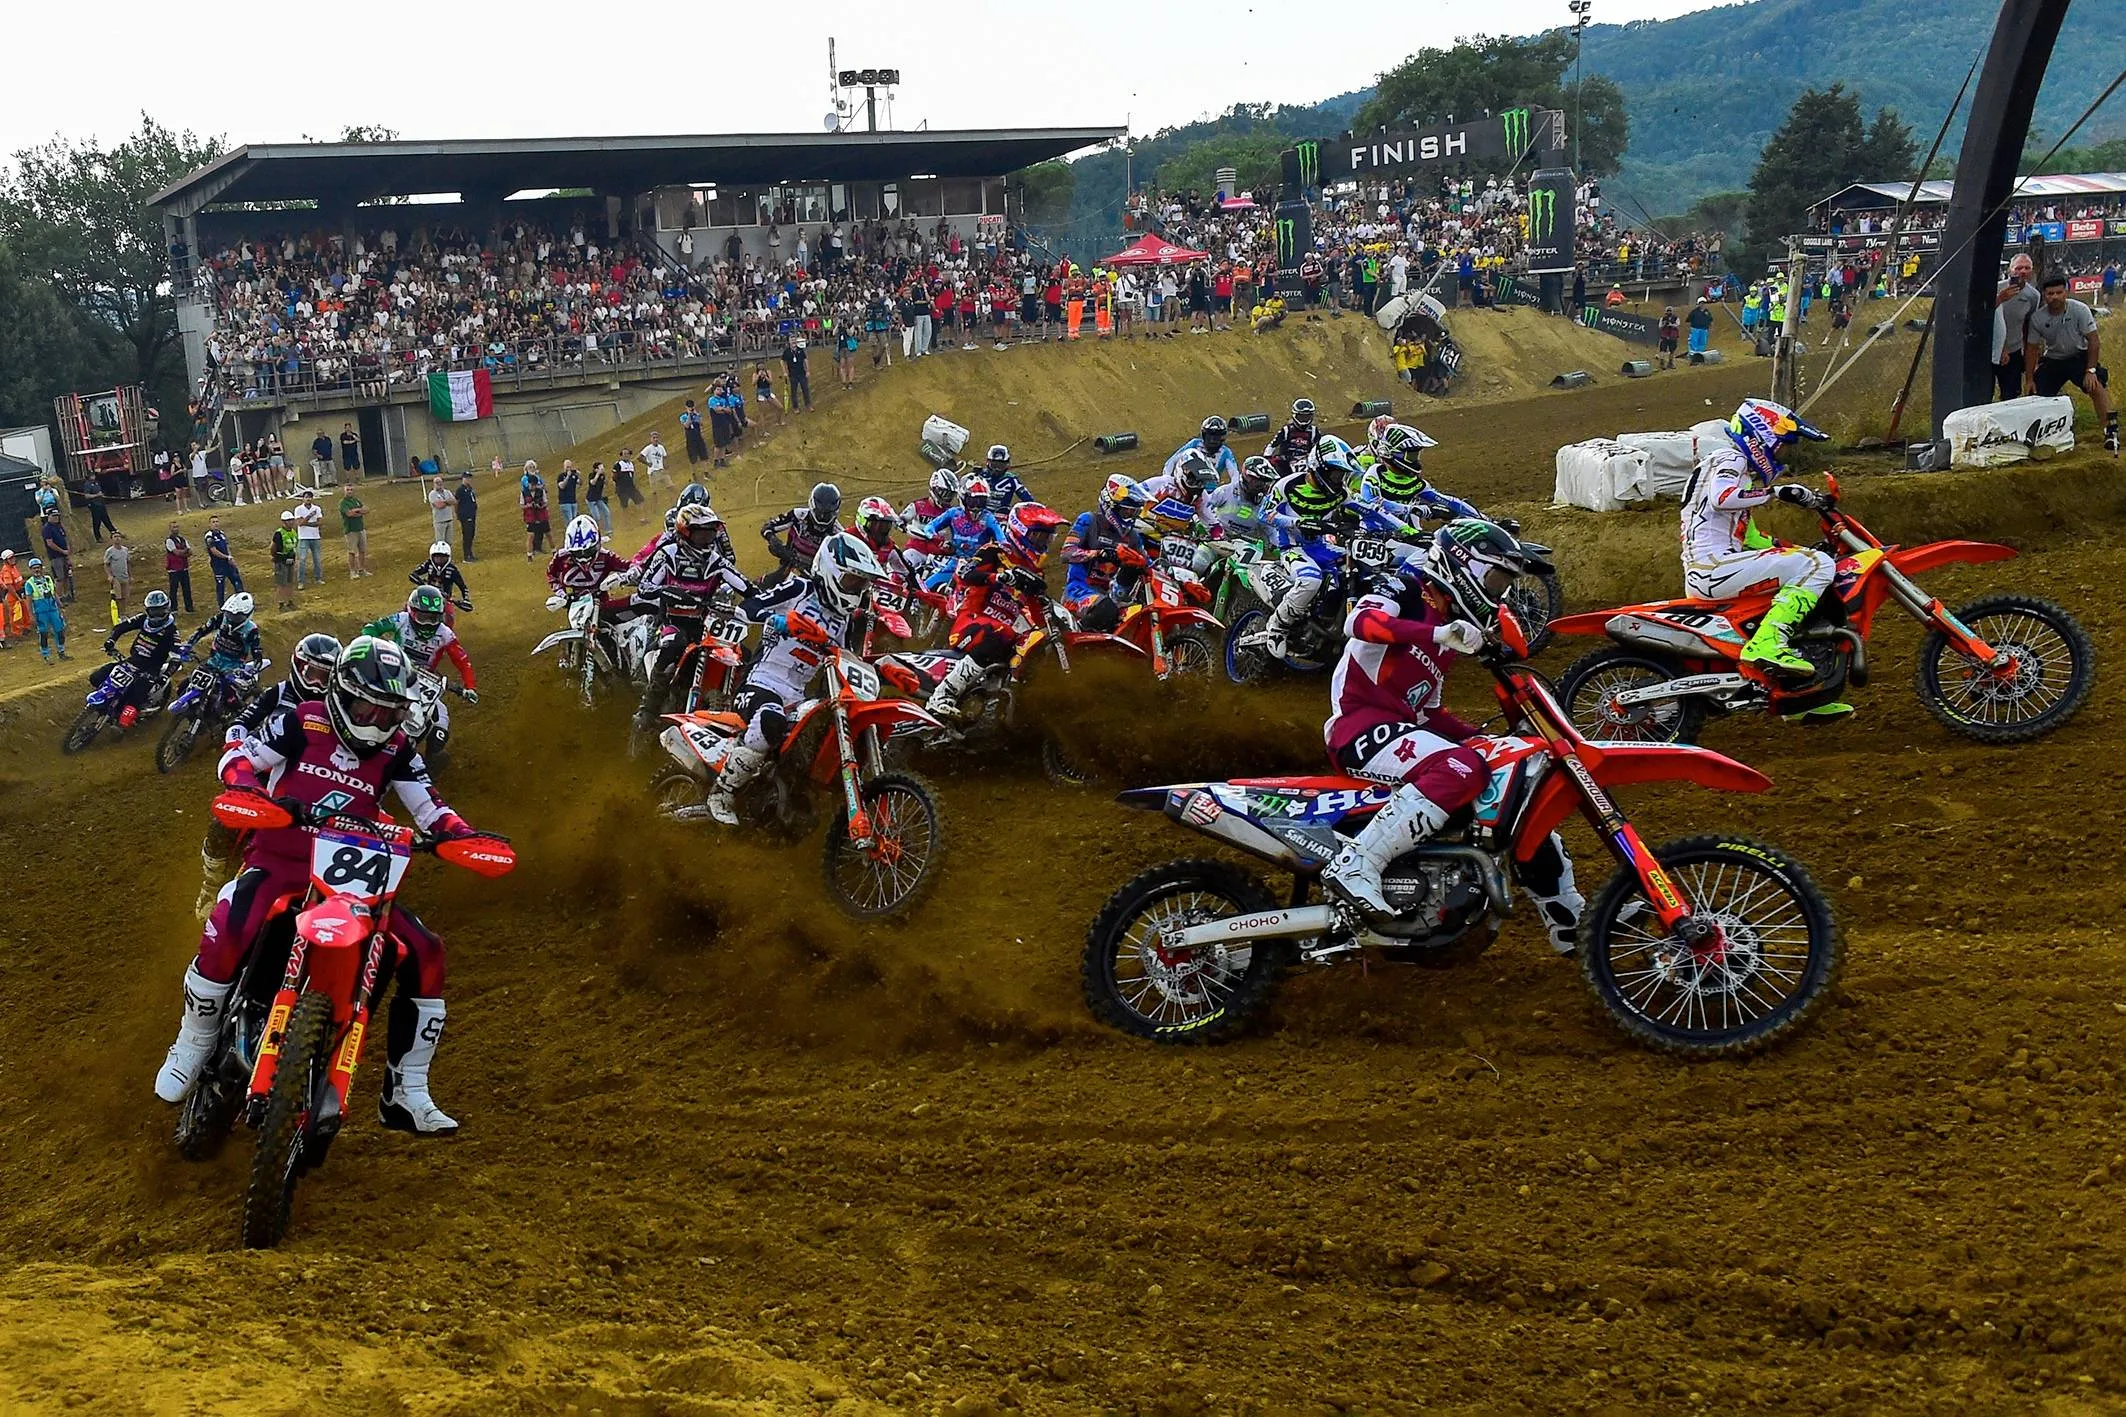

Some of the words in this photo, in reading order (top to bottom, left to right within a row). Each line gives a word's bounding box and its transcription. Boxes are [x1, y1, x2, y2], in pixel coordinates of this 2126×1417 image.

[1351, 131, 1467, 169] FINISH
[2071, 222, 2097, 231] Beta
[1601, 316, 1646, 332] MONSTER
[1745, 411, 1778, 447] 100%
[2038, 416, 2067, 438] UFO
[1168, 542, 1196, 558] 303
[1355, 541, 1386, 562] 959
[1449, 545, 1470, 563] FOX
[1261, 571, 1287, 591] 959
[1455, 573, 1482, 607] MONSTER
[877, 591, 904, 610] 24
[1160, 581, 1180, 607] 5
[574, 606, 586, 620] 4
[984, 606, 1013, 626] DUCA
[1664, 613, 1714, 628] 80
[709, 620, 744, 641] 811
[1409, 644, 1446, 682] HONDA
[847, 666, 877, 692] 83
[1354, 721, 1416, 761] FOX
[298, 762, 376, 796] HONDA
[1346, 767, 1405, 785] HONDA
[1284, 828, 1306, 848] Satu
[1716, 842, 1787, 868] PIRELLI
[323, 846, 392, 895] 84
[1228, 915, 1280, 932] CHOHO
